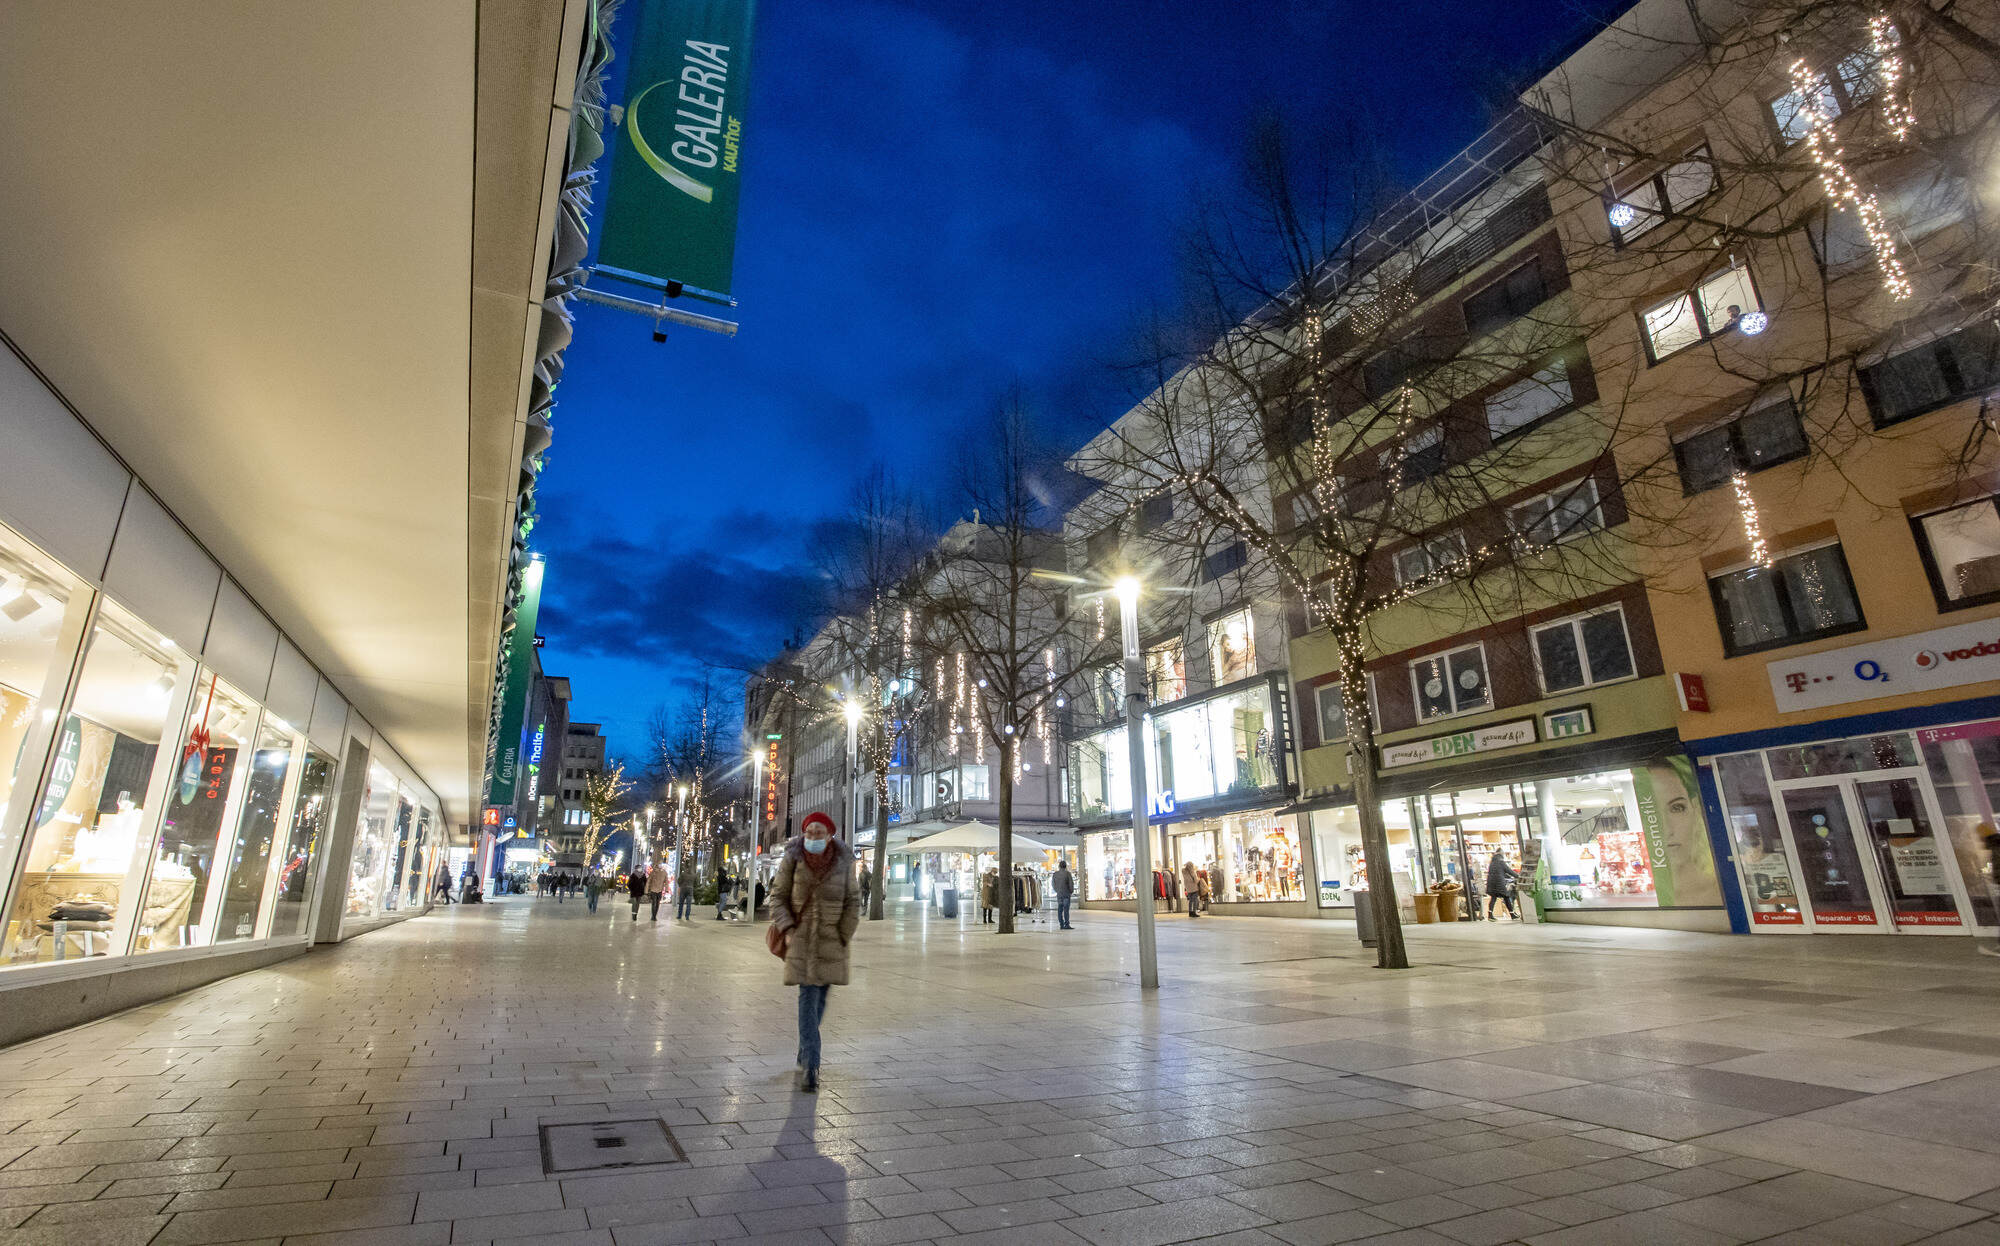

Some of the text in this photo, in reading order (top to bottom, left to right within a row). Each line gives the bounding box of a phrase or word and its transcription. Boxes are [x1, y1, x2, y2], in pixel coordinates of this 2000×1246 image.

[671, 40, 730, 168] GALERIA
[1942, 638, 2000, 662] voda
[1432, 732, 1476, 757] EDEN
[1481, 732, 1508, 746] gesund
[1514, 731, 1525, 743] fit
[503, 747, 516, 778] GALERIA
[767, 742, 778, 821] apotheke
[1640, 791, 1668, 868] Kosmetik
[1321, 892, 1338, 901] EDEN
[1552, 889, 1577, 901] EDEN
[1857, 914, 1874, 922] DSL
